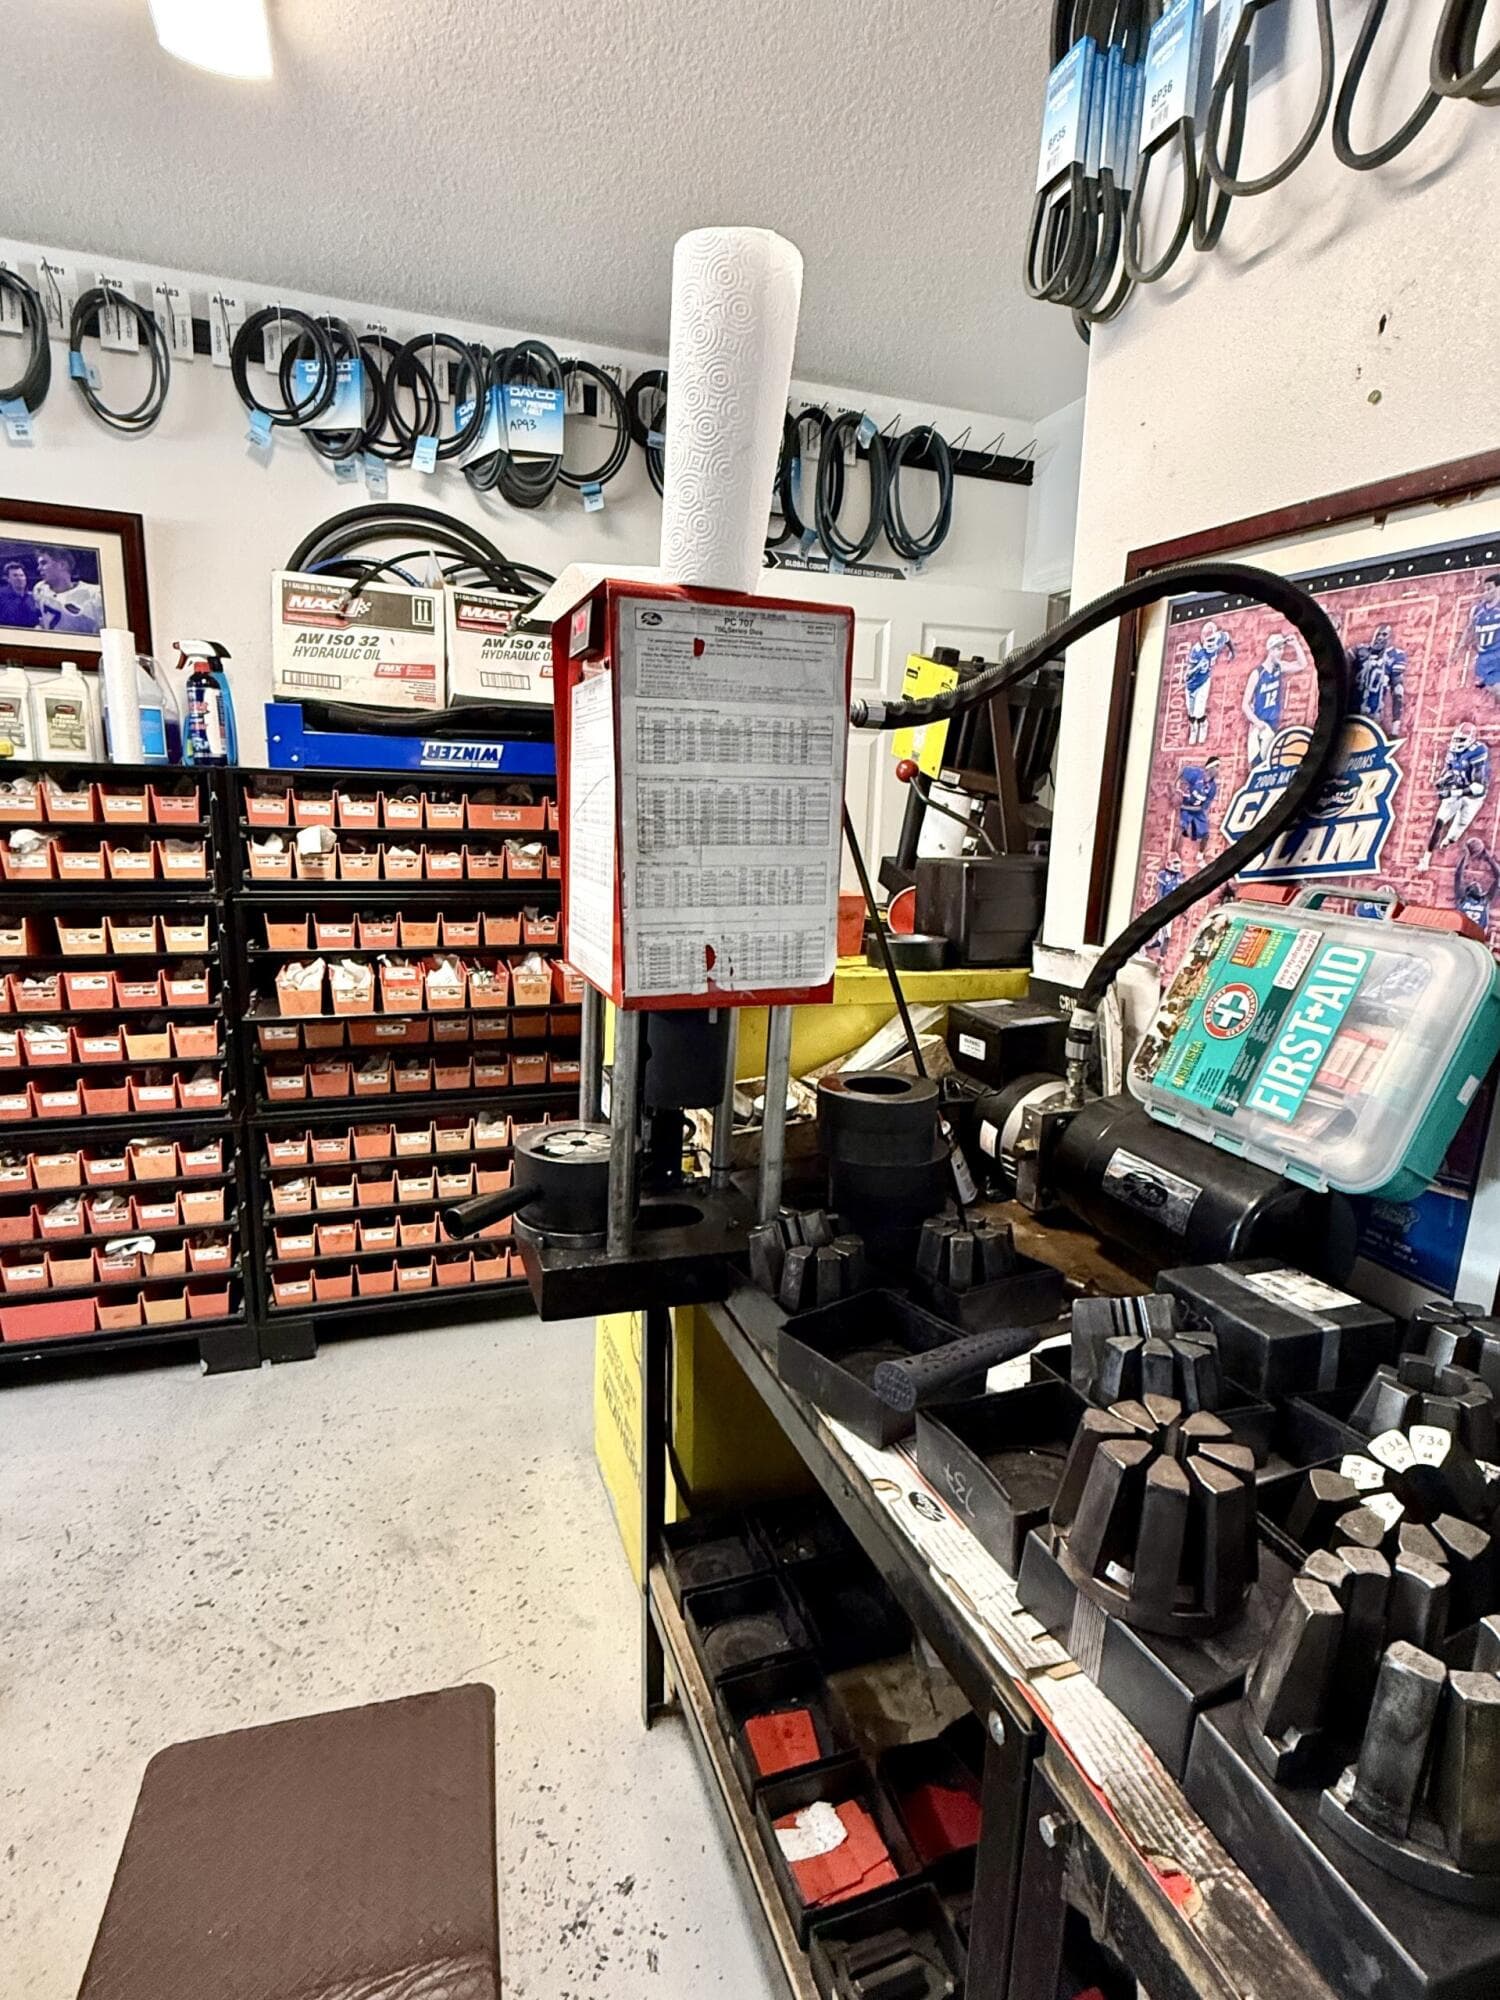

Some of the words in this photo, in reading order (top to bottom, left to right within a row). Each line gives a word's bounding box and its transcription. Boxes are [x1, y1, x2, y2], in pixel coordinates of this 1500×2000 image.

[509, 386, 557, 400] DAYCO
[510, 419, 537, 431] AP93
[295, 633, 324, 645] AW
[326, 634, 355, 647] ISO
[358, 636, 380, 647] 32
[482, 638, 505, 649] AW
[509, 639, 533, 650] ISO
[292, 646, 362, 660] HYDRAULIC
[363, 648, 382, 661] OIL
[481, 649, 541, 662] HYDRAULIC
[428, 744, 500, 762] WINZER
[1254, 771, 1276, 790] 2006
[1251, 1010, 1333, 1119] FIRST
[1304, 946, 1368, 1012] AID
